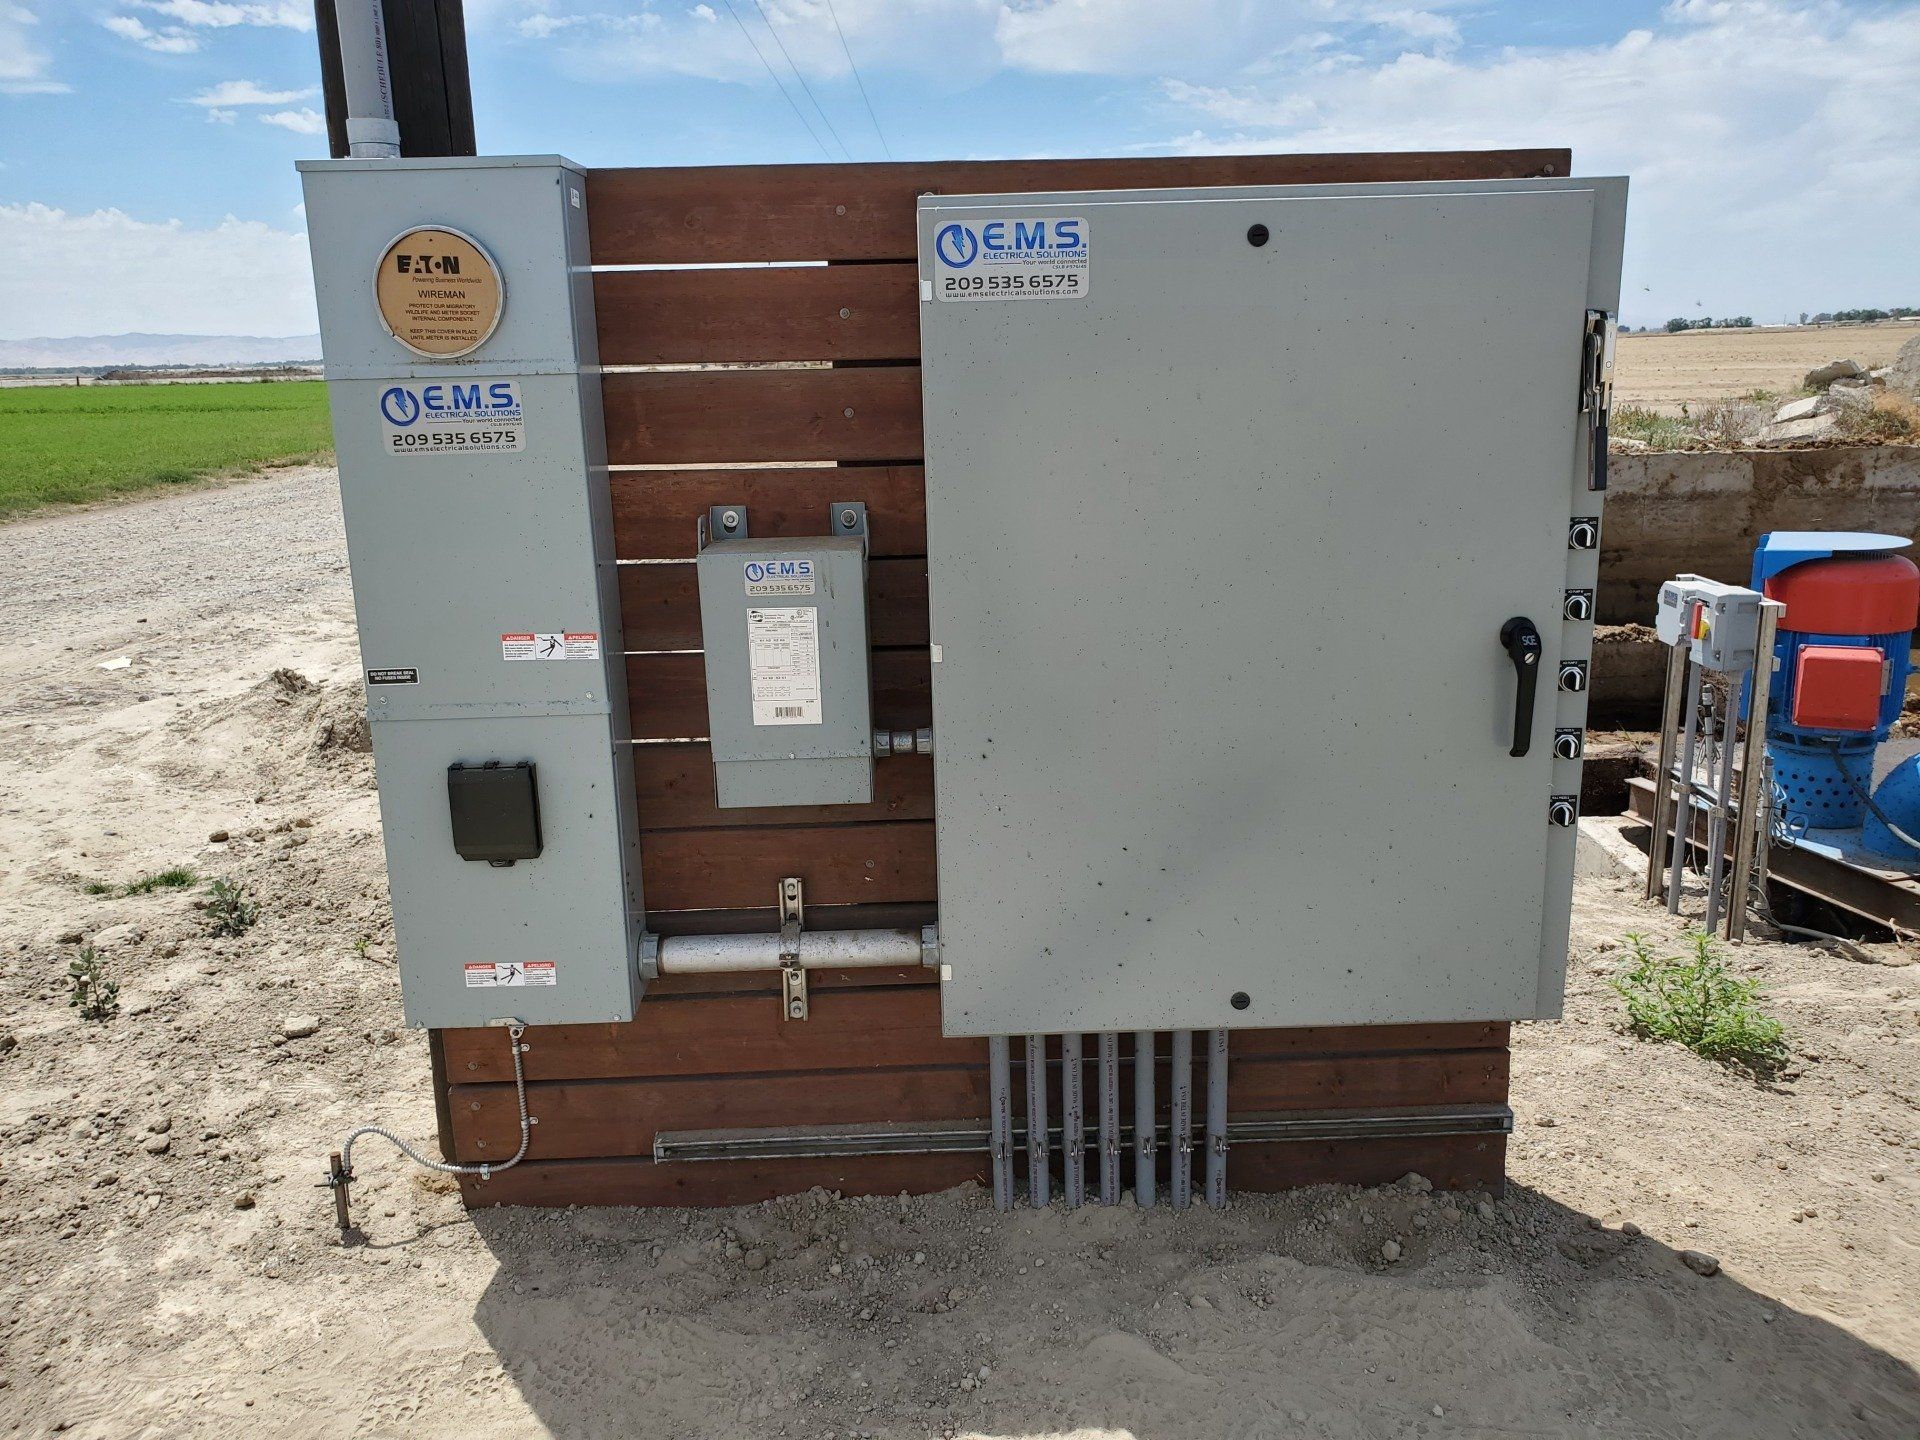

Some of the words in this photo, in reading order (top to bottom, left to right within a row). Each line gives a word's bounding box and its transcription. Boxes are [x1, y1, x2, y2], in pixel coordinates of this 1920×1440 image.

[982, 220, 1086, 250] E.M.S.
[983, 252, 1034, 260] ELECTRICAL
[1036, 250, 1087, 258] SOLUTIONS
[945, 276, 984, 290] 209
[988, 276, 1024, 290] 535
[1029, 274, 1078, 288] 6575
[418, 290, 466, 299] WIREMAN
[946, 289, 1078, 298] www.emselectricalsolutions.com
[423, 384, 520, 410] E.M.S.
[425, 411, 472, 419] ELECTRICAL
[474, 410, 522, 418] SOLUTIONS
[392, 434, 428, 446] 209
[432, 432, 466, 445] 535
[470, 431, 516, 444] 6575
[394, 444, 517, 452] www.emselectricalsolutions.com
[766, 562, 813, 574] E.M.S.
